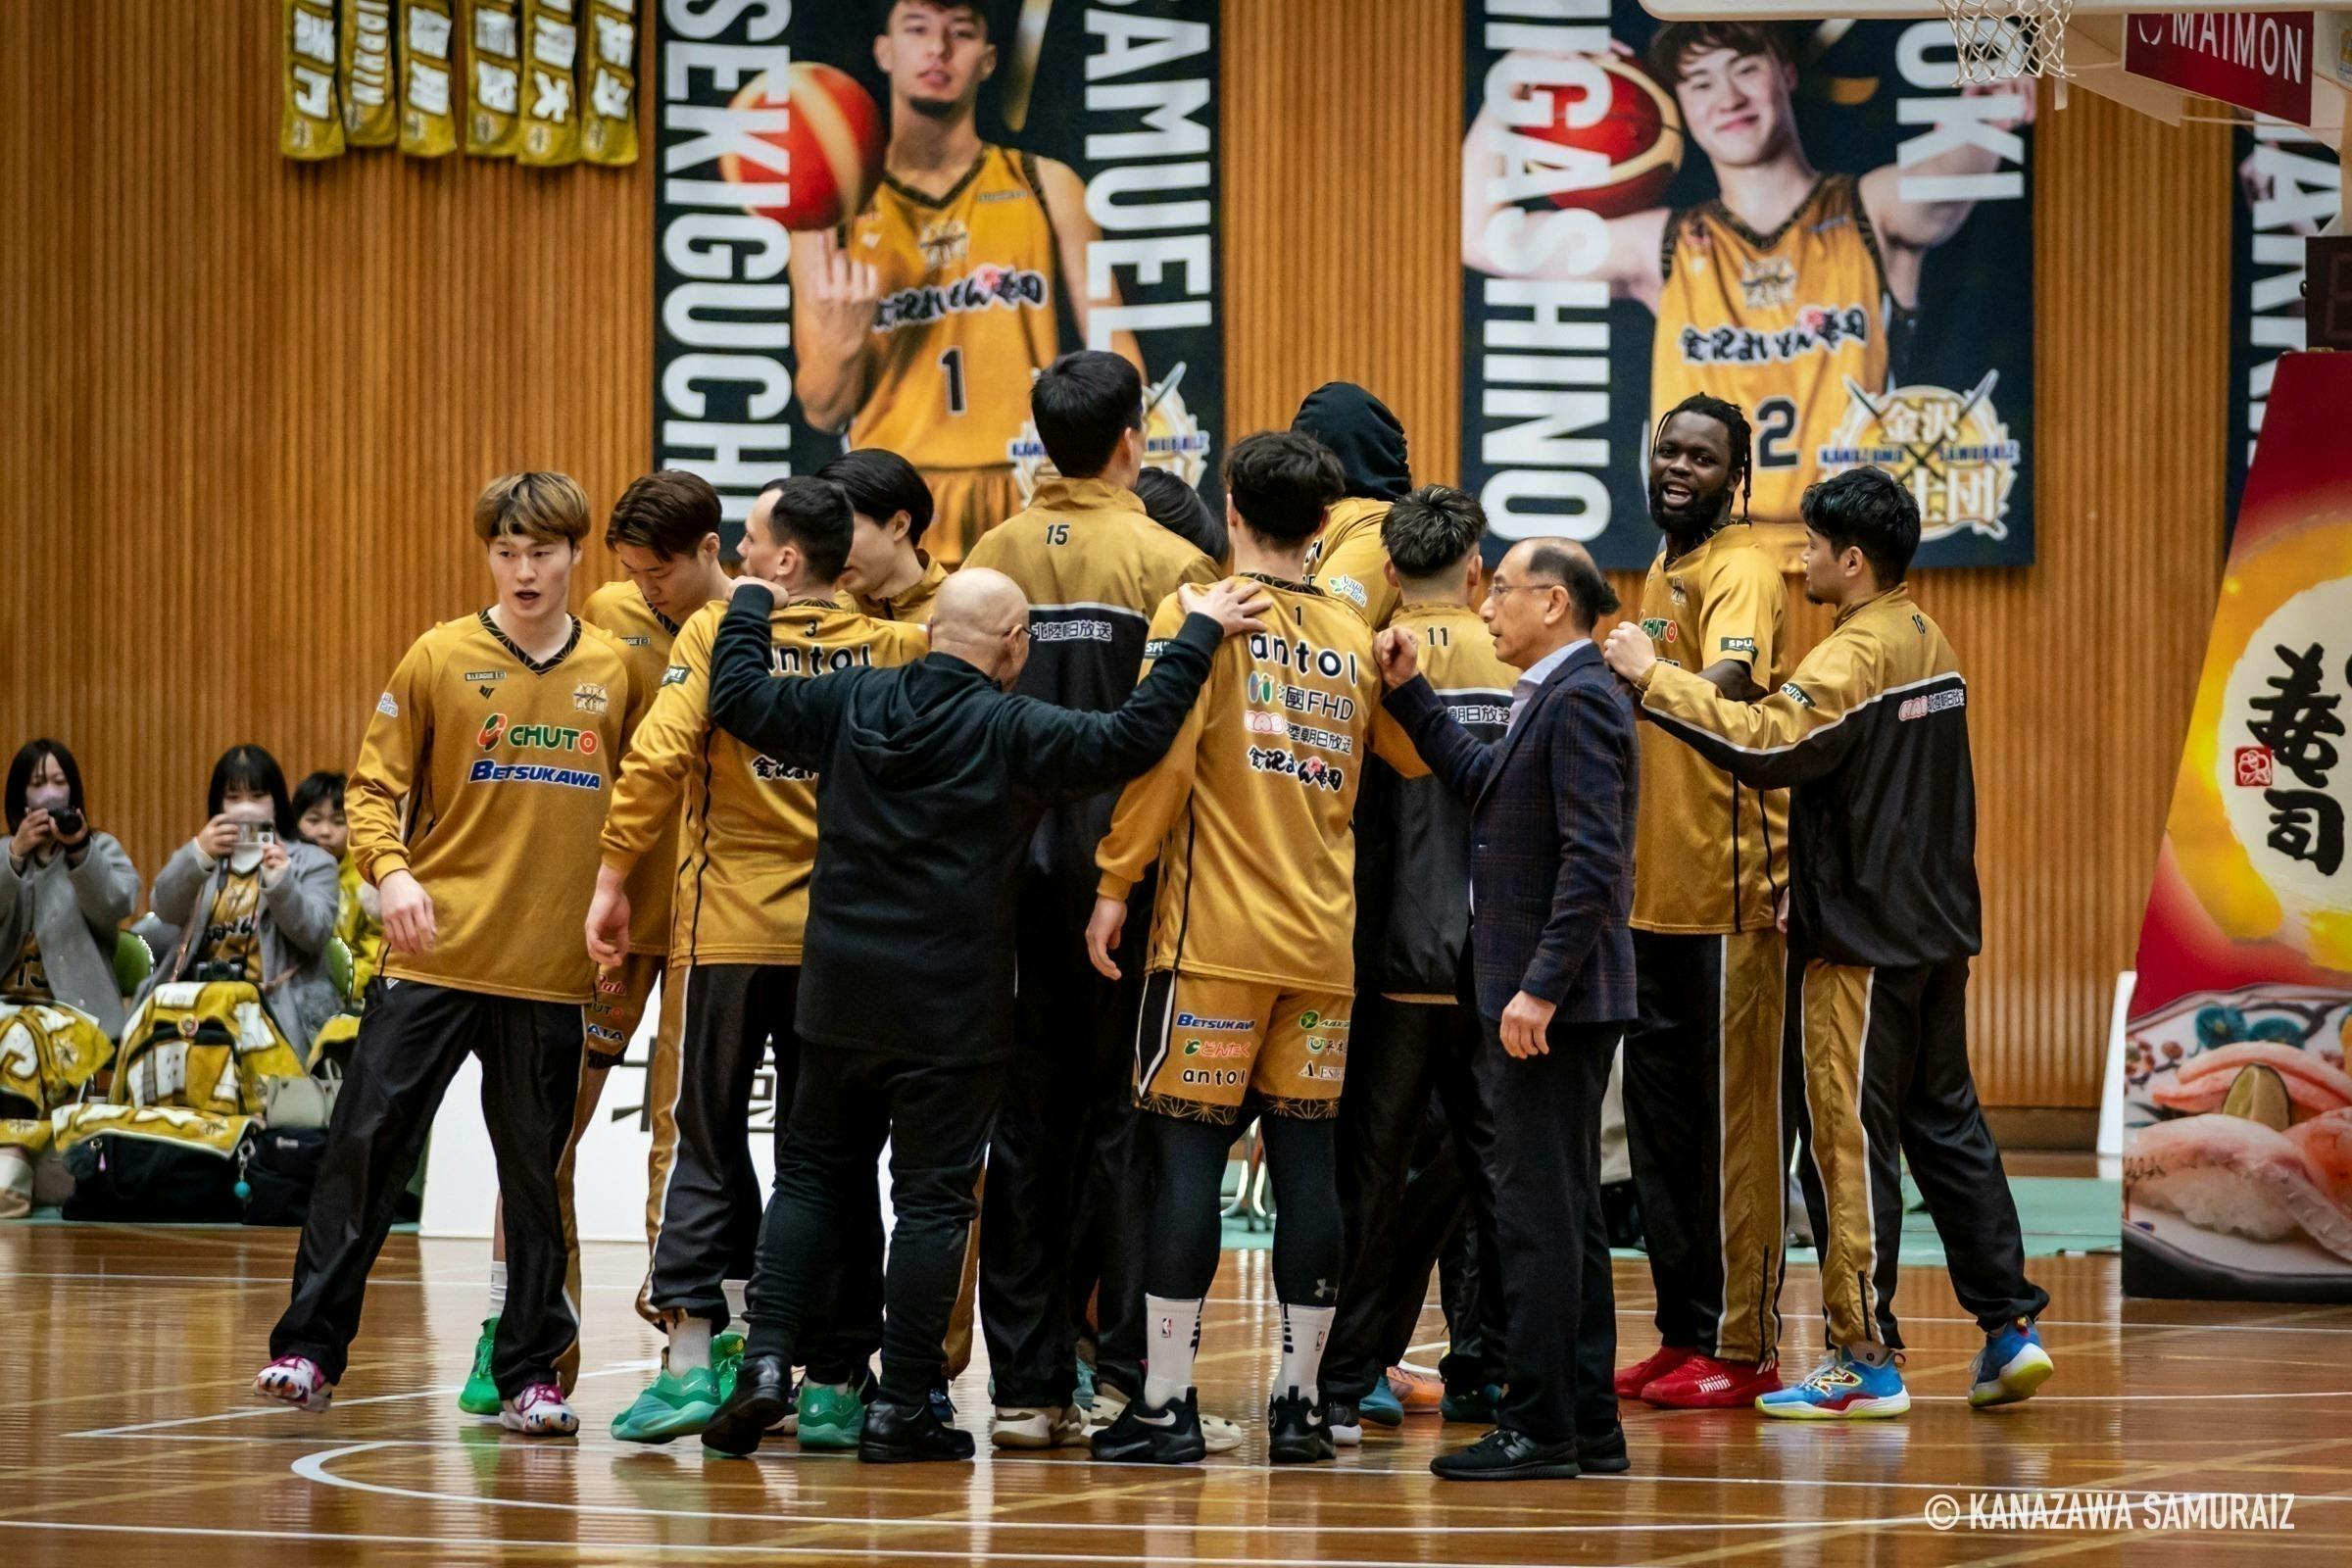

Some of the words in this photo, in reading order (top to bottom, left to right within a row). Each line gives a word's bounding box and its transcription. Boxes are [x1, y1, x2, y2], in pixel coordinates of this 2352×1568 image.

[2171, 13, 2303, 84] MAIMON
[1084, 0, 1211, 352] AMUEL
[941, 347, 966, 414] 1
[1757, 400, 1798, 467] 2
[1046, 523, 1070, 546] 15
[805, 619, 818, 637] 3
[1295, 606, 1302, 626] 1
[1911, 614, 1927, 635] 18
[1427, 626, 1448, 647] 11
[768, 644, 870, 676] ntol
[1250, 633, 1356, 686] antol
[1782, 682, 1811, 707] PURT
[509, 725, 599, 756] CHUTO
[1285, 721, 1352, 754] 陸朝日放送
[470, 760, 601, 790] BETSUKAWA
[1182, 1069, 1247, 1086] antol
